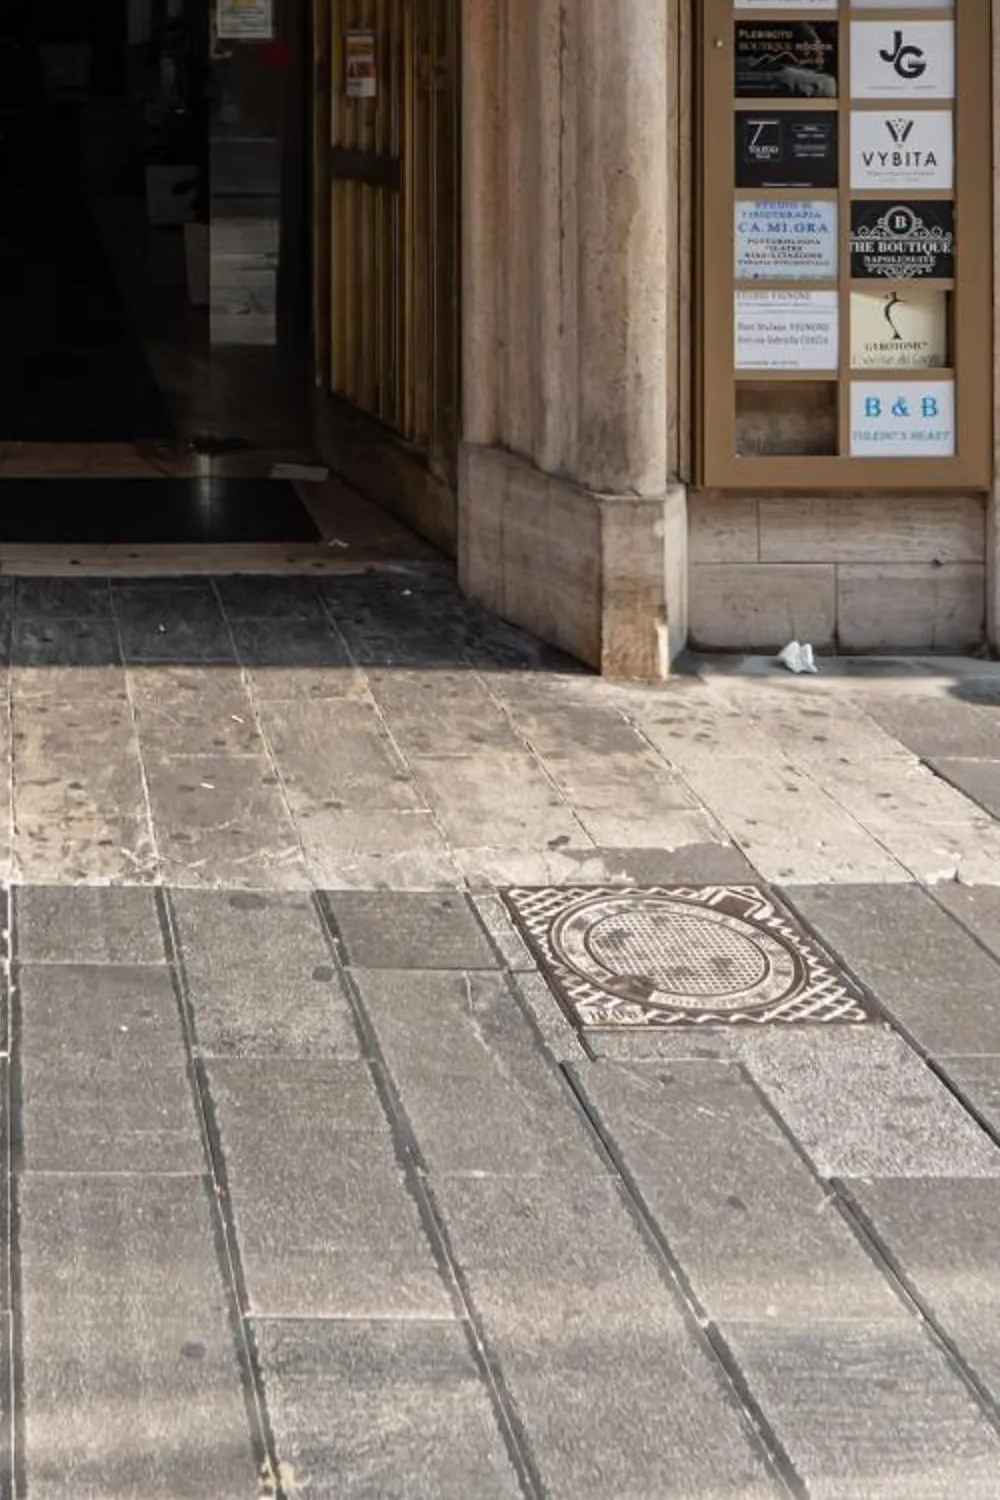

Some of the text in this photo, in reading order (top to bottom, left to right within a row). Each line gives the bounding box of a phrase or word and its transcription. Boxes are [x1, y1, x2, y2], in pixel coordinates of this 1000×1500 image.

[861, 151, 938, 167] VYBITA
[864, 396, 939, 418] B & B
